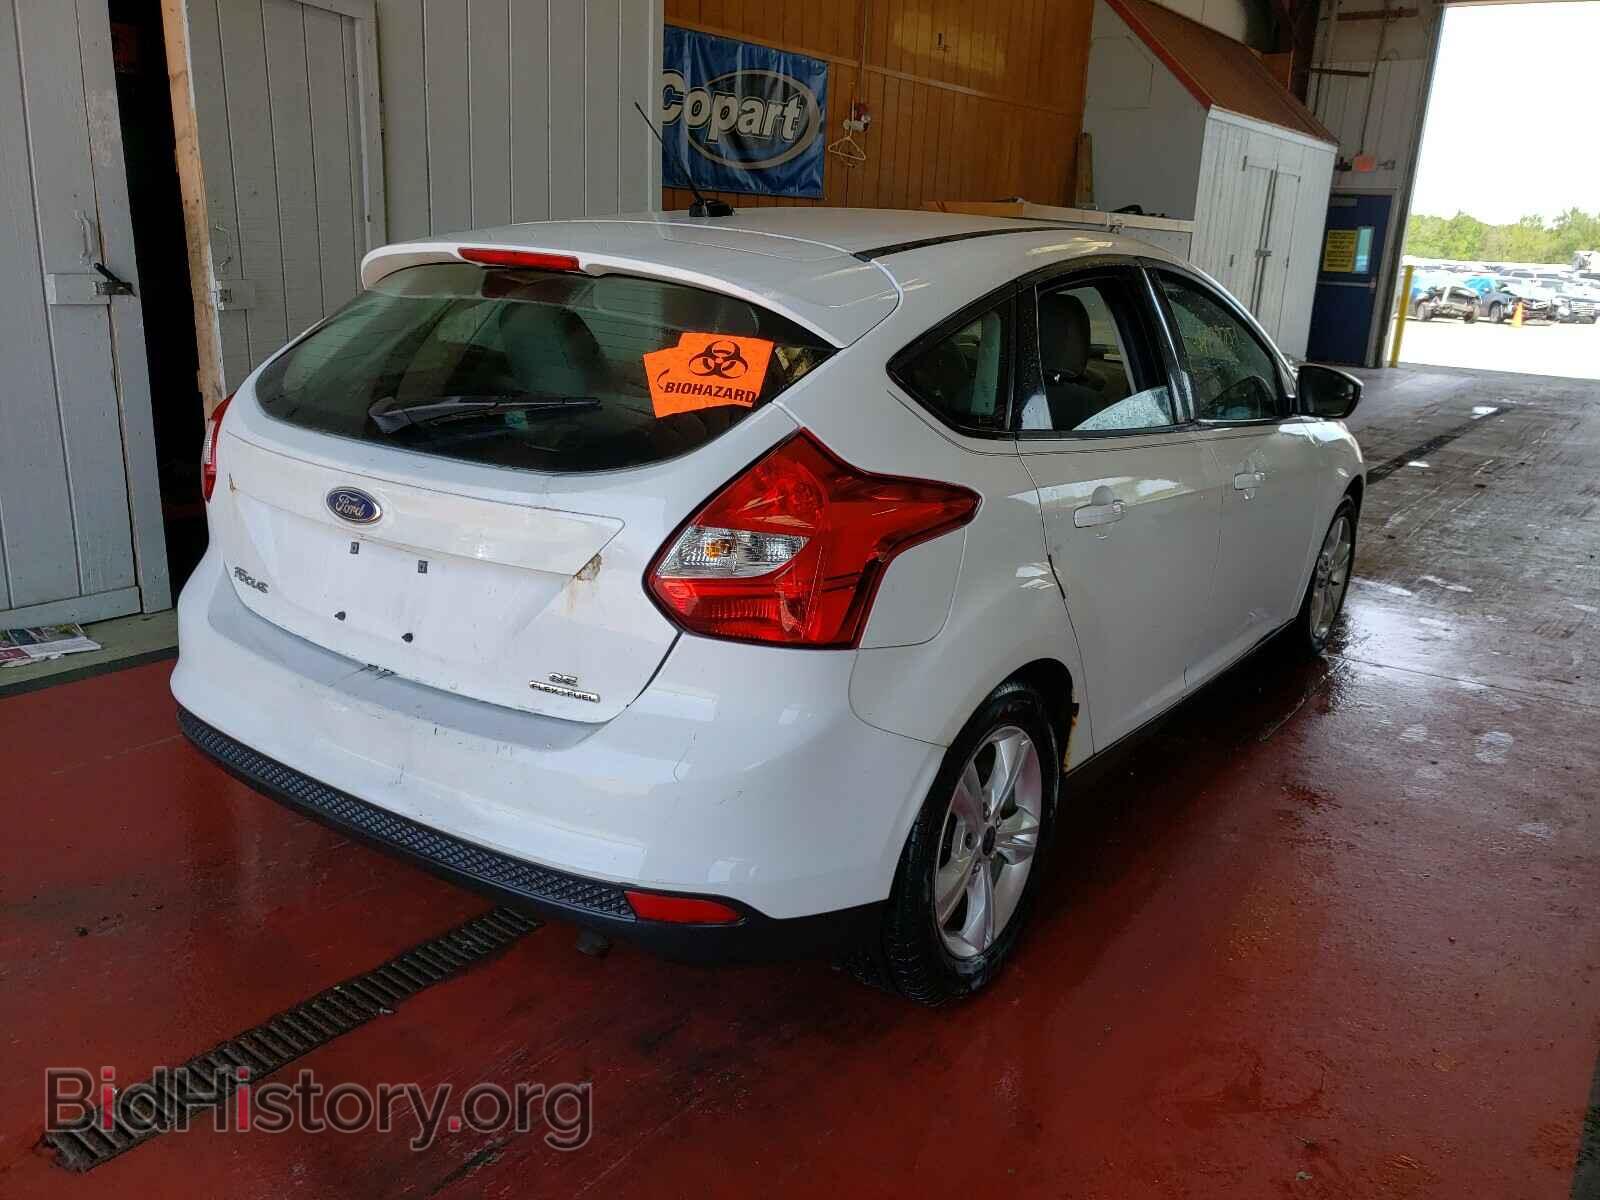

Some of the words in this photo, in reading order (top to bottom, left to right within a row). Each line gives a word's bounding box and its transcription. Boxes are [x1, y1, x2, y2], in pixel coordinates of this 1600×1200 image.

[662, 69, 802, 143] Copart
[664, 381, 757, 404] BIOHAZARD
[335, 494, 366, 517] Ford
